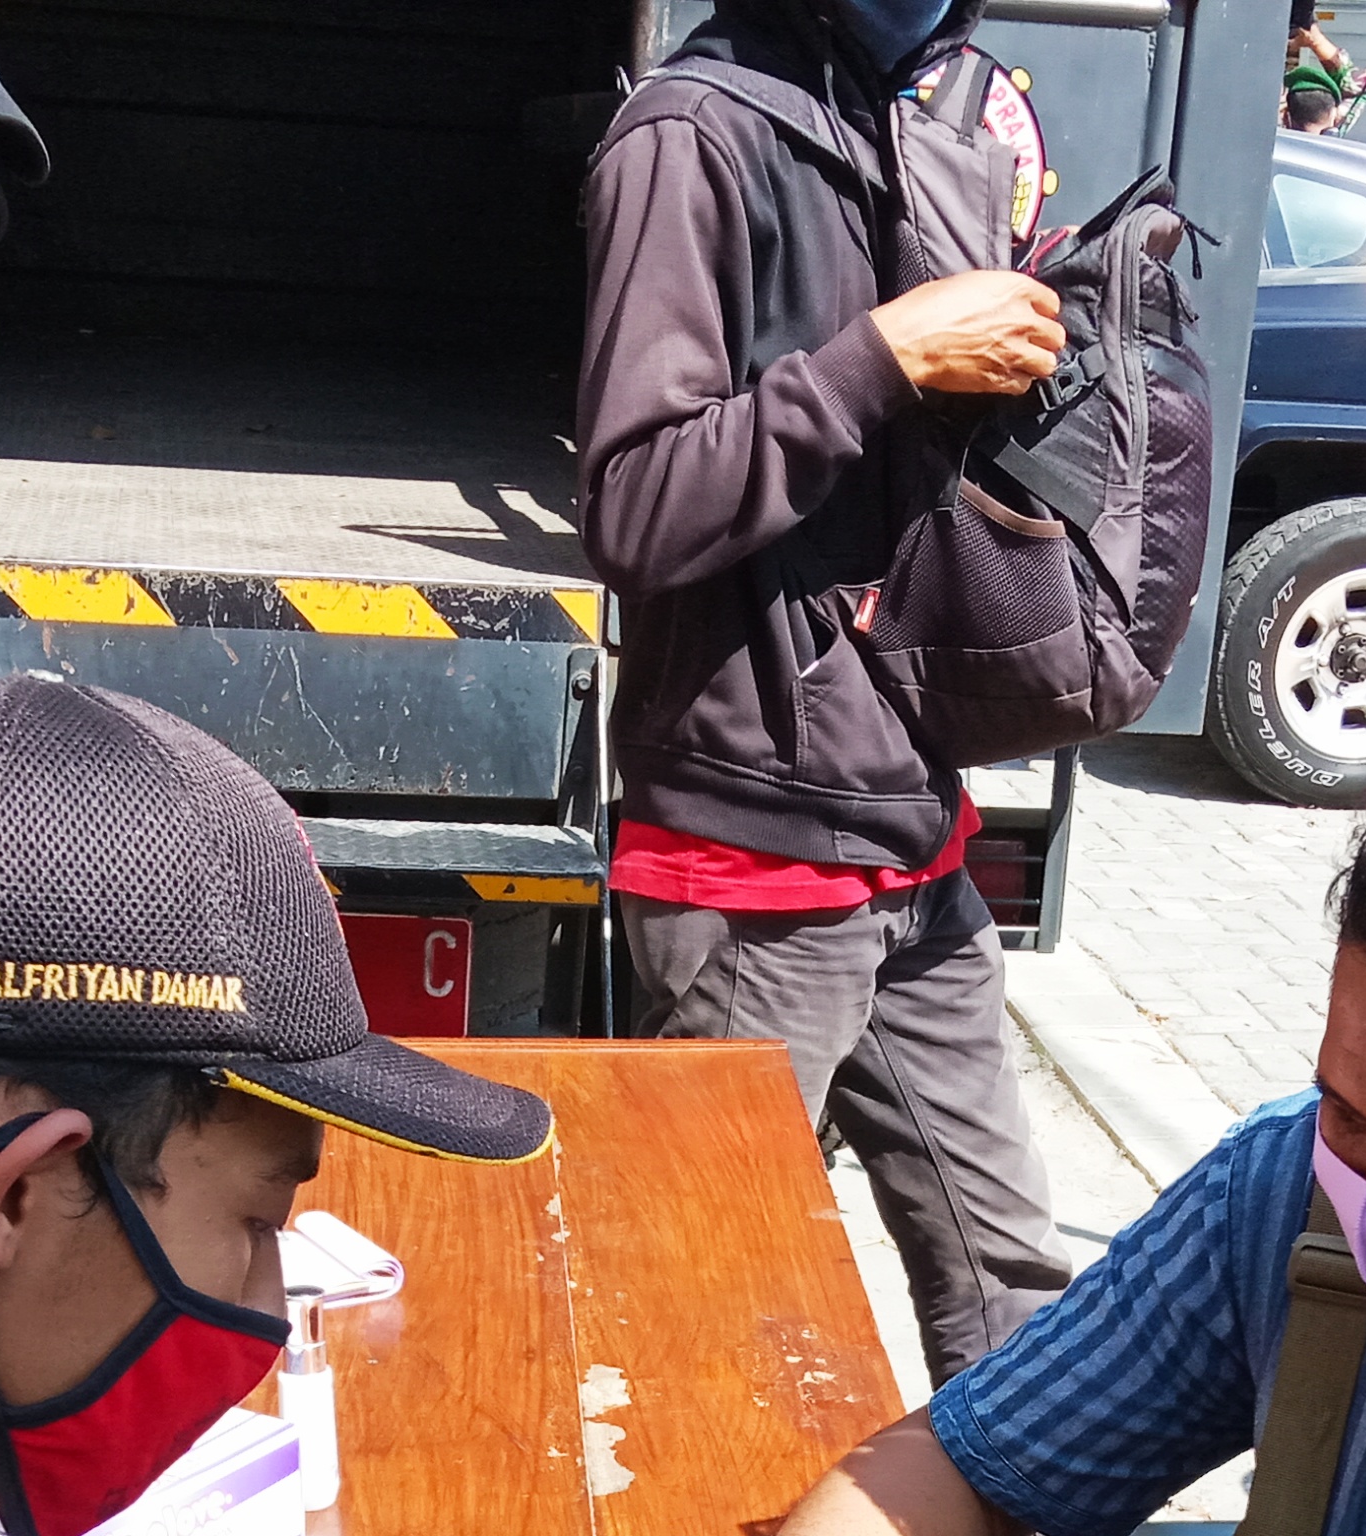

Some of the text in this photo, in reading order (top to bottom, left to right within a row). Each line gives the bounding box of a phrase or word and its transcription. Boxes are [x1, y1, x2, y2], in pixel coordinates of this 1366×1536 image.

[989, 85, 1035, 169] PRAJA
[1247, 660, 1343, 787] DUELER
[150, 970, 248, 1013] DAMAR
[423, 929, 457, 998] C
